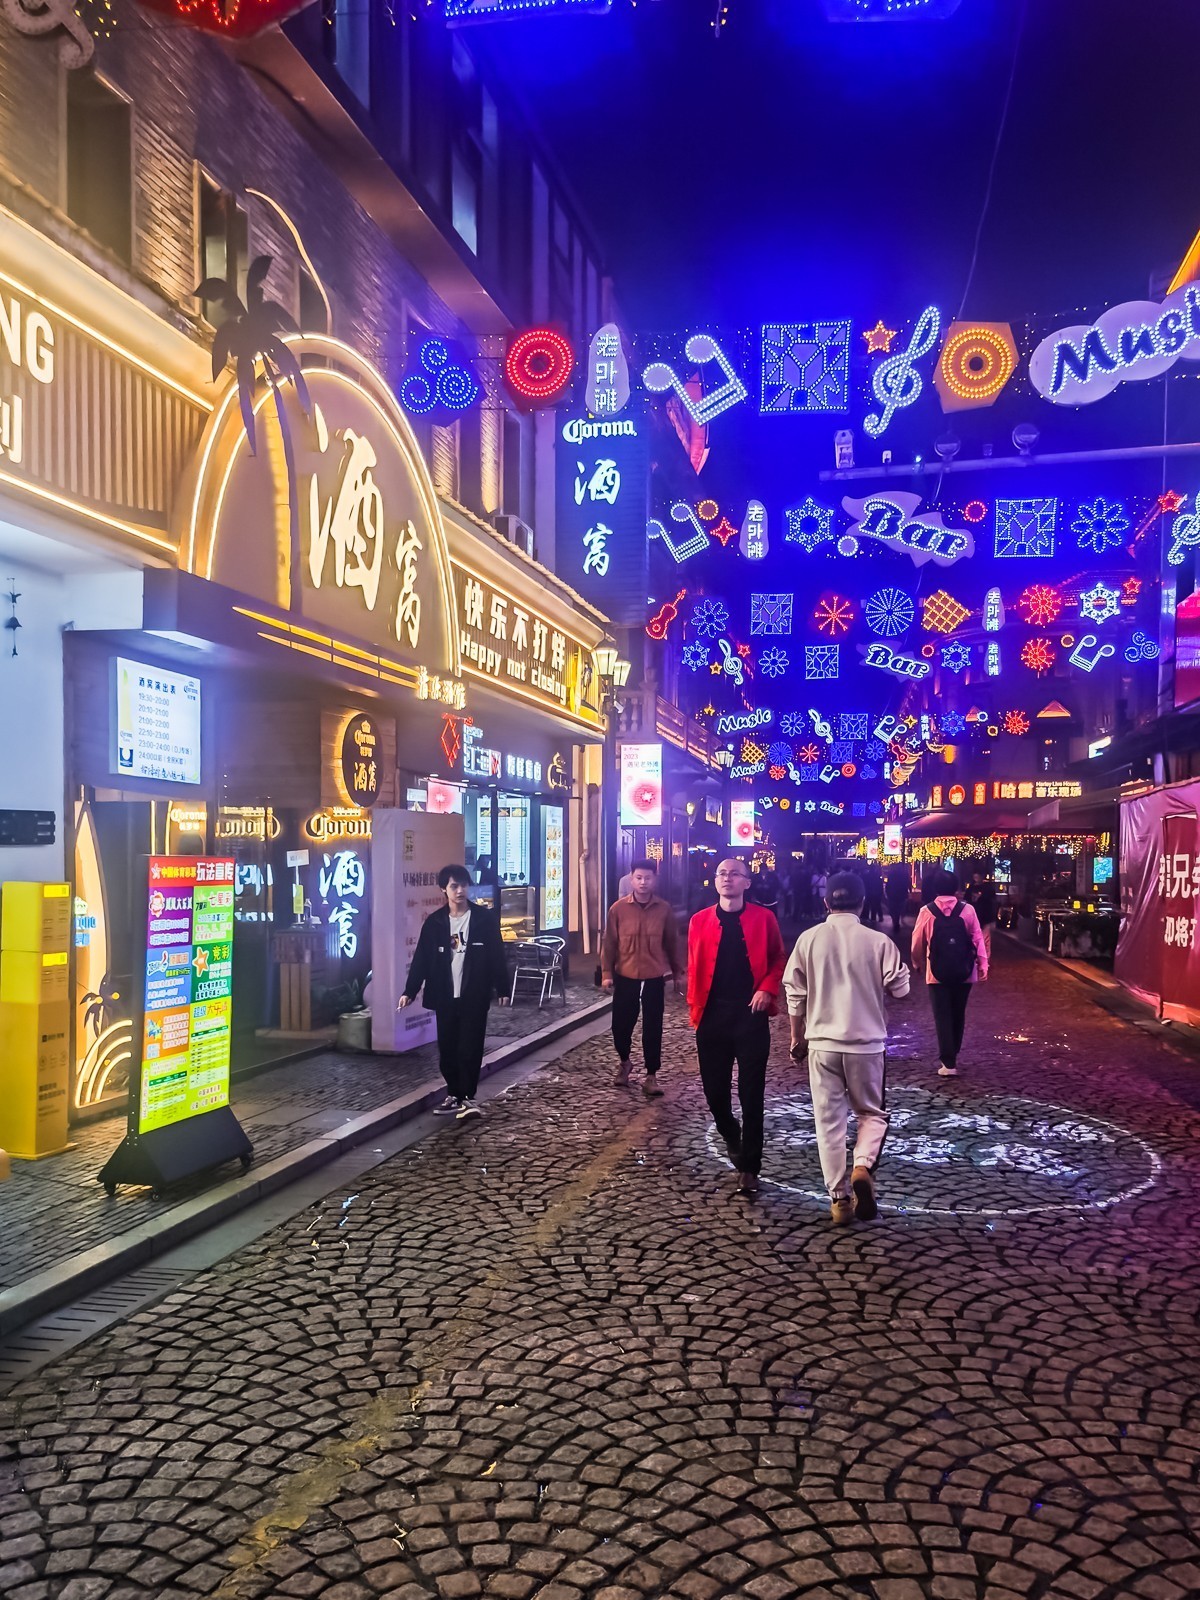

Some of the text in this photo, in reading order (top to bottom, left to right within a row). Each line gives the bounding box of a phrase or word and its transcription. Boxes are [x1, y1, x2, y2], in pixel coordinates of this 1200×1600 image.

[746, 504, 763, 559] 老外滩
[859, 498, 969, 559] Bar
[464, 577, 567, 672] 快乐不打烊
[985, 590, 1001, 632] 老外滩
[460, 629, 567, 706] Happy not closing
[866, 643, 930, 680] Bar
[987, 642, 1000, 677] 老外滩
[716, 708, 772, 735] Music
[730, 761, 766, 779] Music
[1035, 786, 1082, 798] 音乐现场
[196, 862, 234, 882] 玩法宣传
[212, 944, 230, 961] 竞彩
